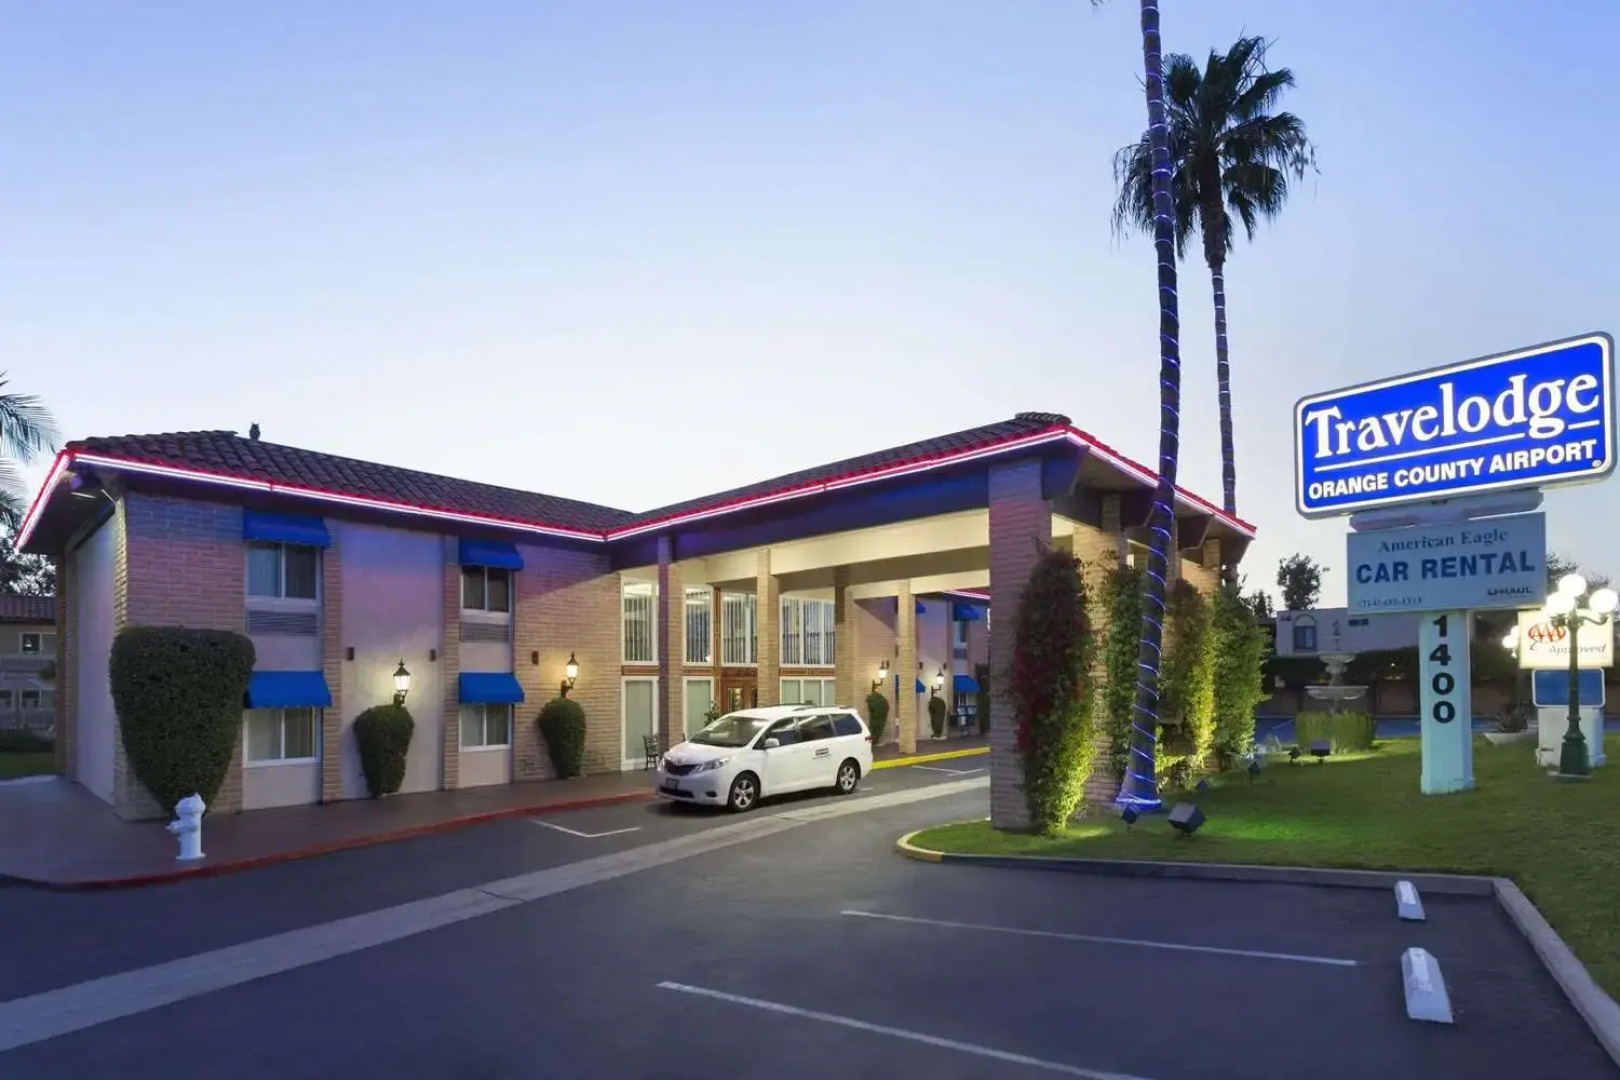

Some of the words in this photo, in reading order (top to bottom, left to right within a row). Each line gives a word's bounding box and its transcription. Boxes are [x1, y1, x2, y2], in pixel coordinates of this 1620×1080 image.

[1305, 373, 1599, 458] Travelodge
[1308, 472, 1389, 499] ORANGE
[1395, 457, 1485, 487] COUNTY
[1489, 439, 1597, 473] AIRPORT
[1356, 561, 1409, 584] CAR
[1421, 550, 1536, 580] RENTAL
[1379, 535, 1455, 552] American
[1461, 529, 1508, 546] Eagle
[1429, 614, 1456, 724] 1400
